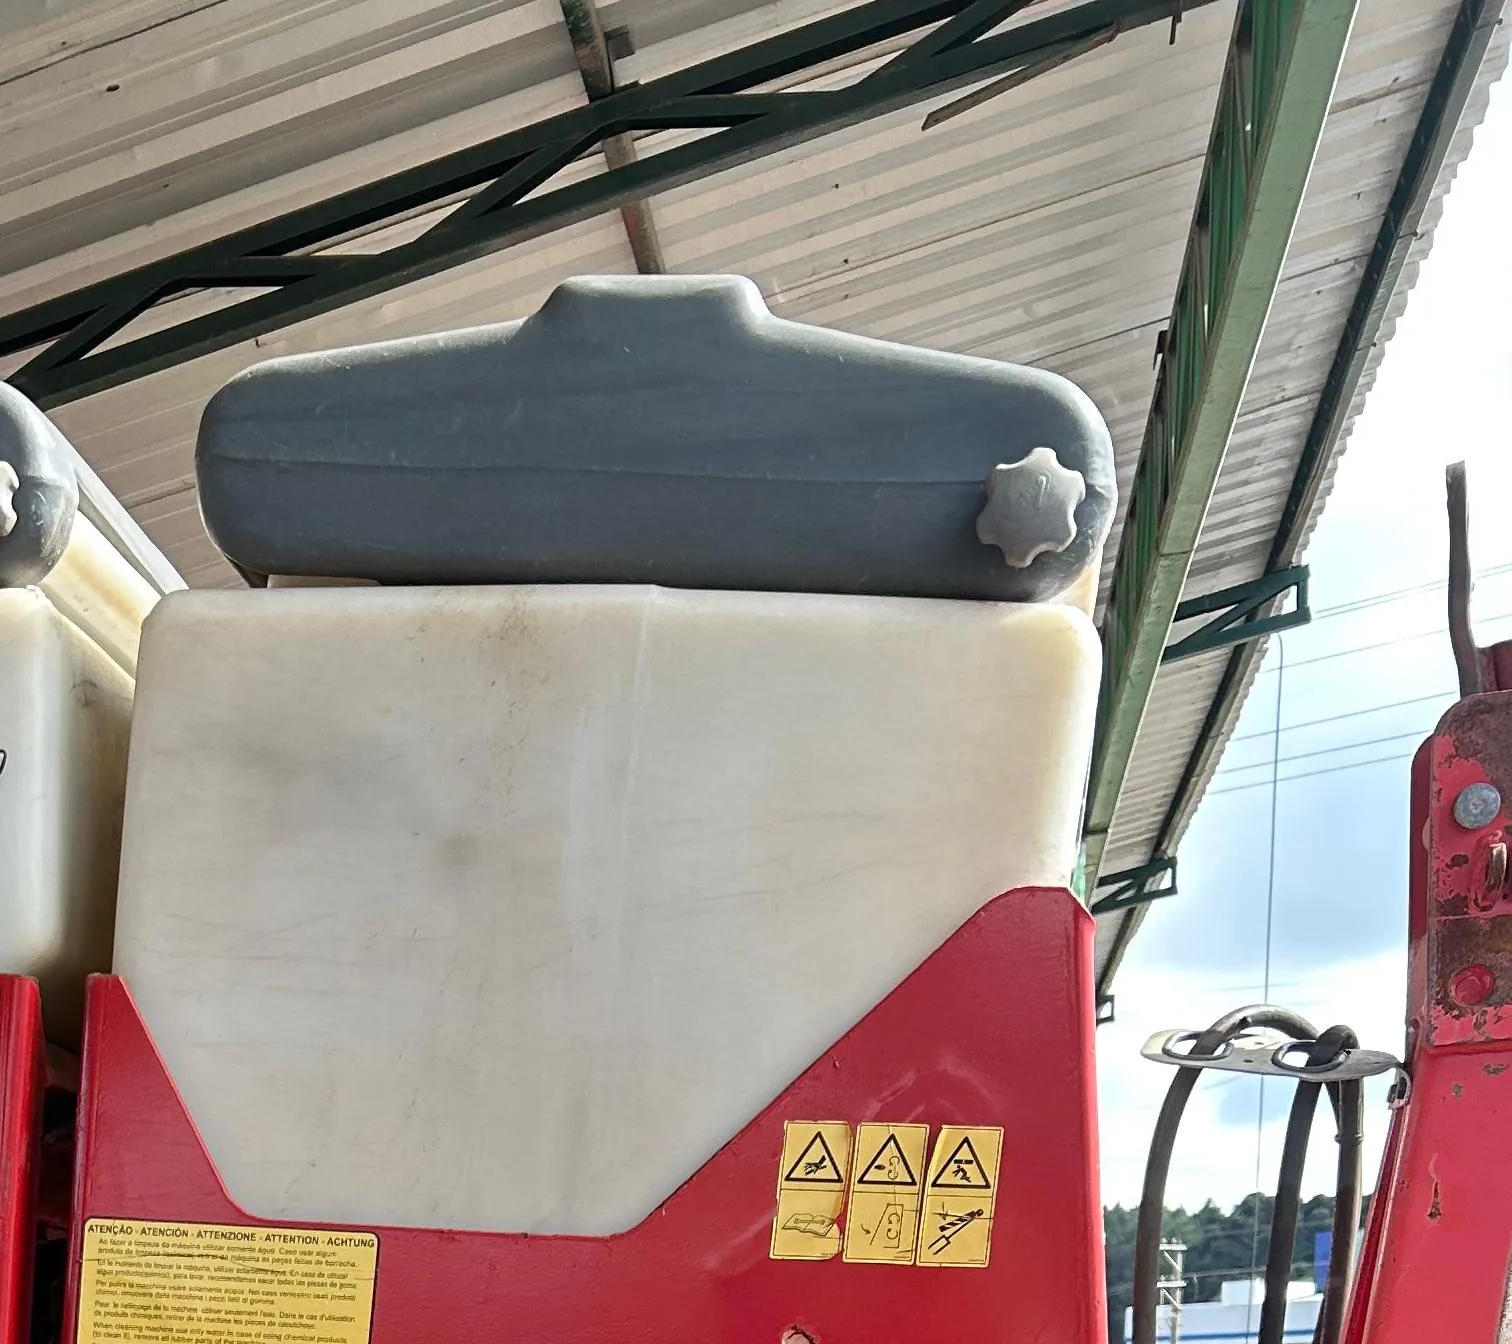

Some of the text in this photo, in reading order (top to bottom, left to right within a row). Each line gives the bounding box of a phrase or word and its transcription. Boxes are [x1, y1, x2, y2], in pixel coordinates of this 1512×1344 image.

[87, 1222, 374, 1248] ATENÇÃO ATENCIÓN ATTENZIONE ATTENTION ACHTUNG
